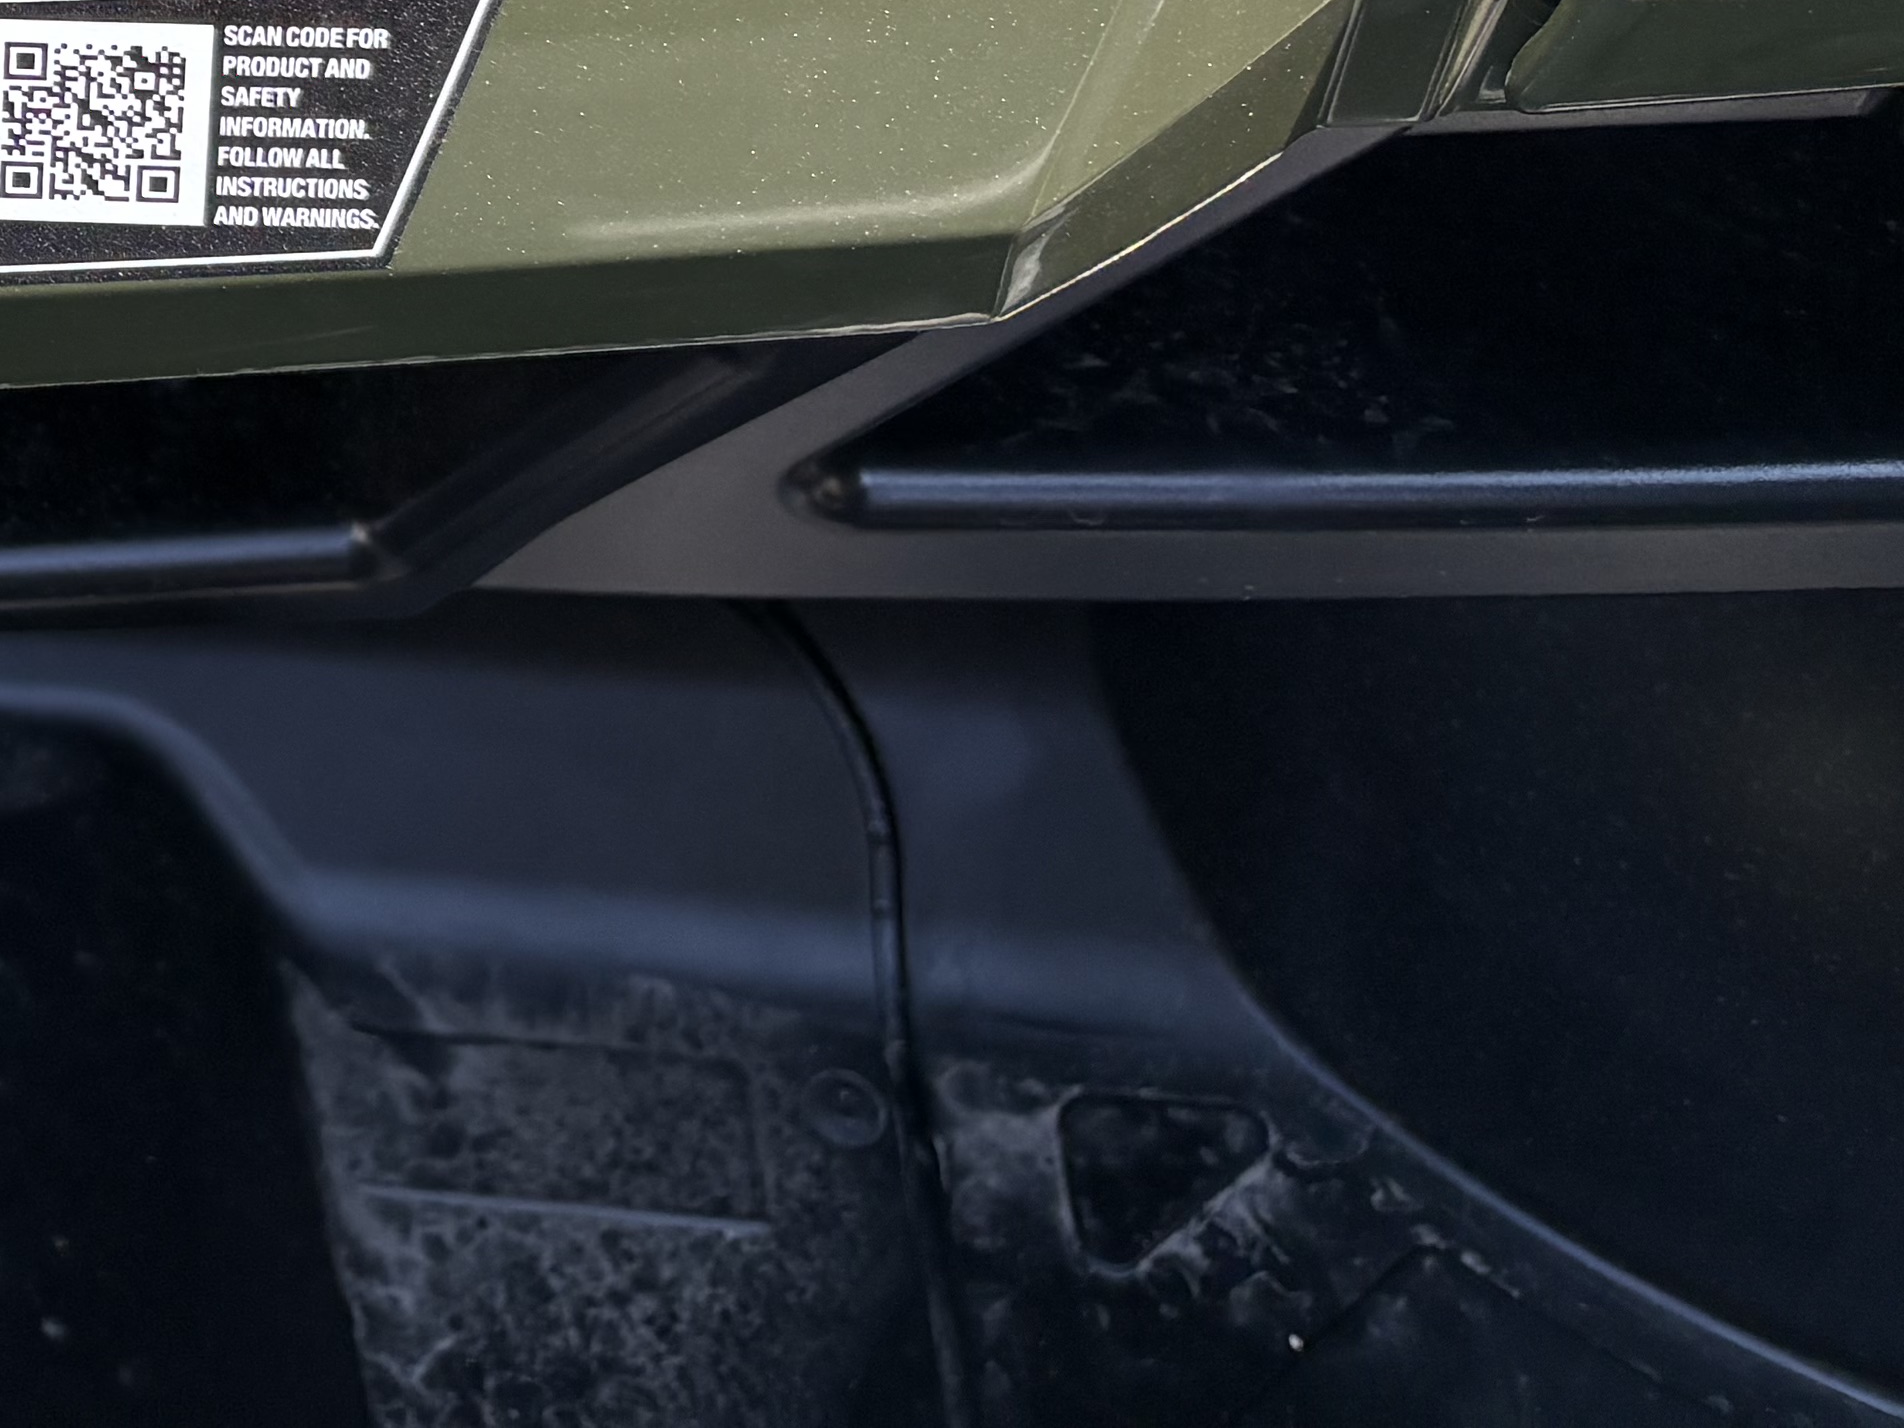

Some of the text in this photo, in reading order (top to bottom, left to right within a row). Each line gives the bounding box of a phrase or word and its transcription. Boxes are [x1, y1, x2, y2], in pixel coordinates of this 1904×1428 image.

[224, 25, 391, 49] SCAN CODE FOR
[223, 56, 372, 79] PRODUCT AND
[221, 86, 301, 107] SAFETY
[219, 116, 373, 140] INFORMATION.
[218, 146, 347, 169] FOLLOW ALL
[216, 176, 370, 200] INSTRUCTIONS
[213, 205, 380, 230] AND WARNINGS.
